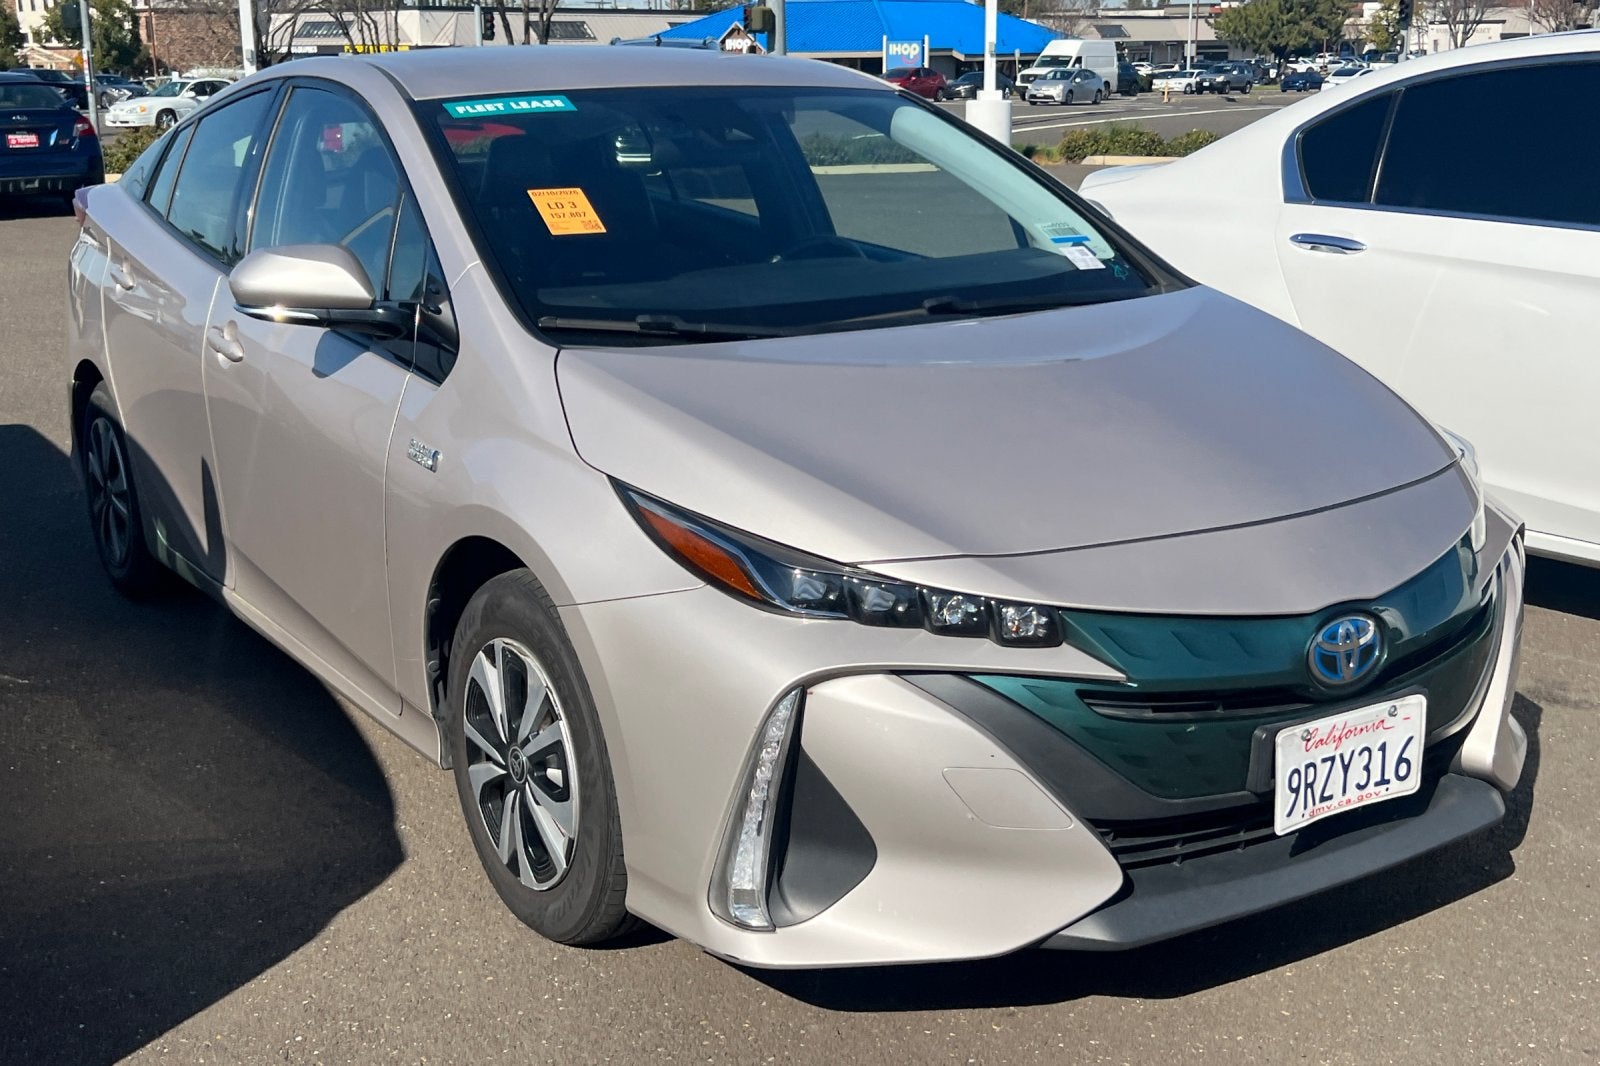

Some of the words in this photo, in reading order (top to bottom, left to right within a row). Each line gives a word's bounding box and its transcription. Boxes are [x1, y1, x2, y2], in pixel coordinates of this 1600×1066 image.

[888, 43, 920, 60] IHOP
[455, 102, 505, 114] FLEET
[509, 99, 566, 110] LEASE
[546, 201, 565, 210] LD
[568, 201, 578, 209] 3
[1304, 718, 1395, 753] California
[1286, 735, 1415, 818] 9RZY316
[1308, 790, 1382, 818] dmv.ca.gov
